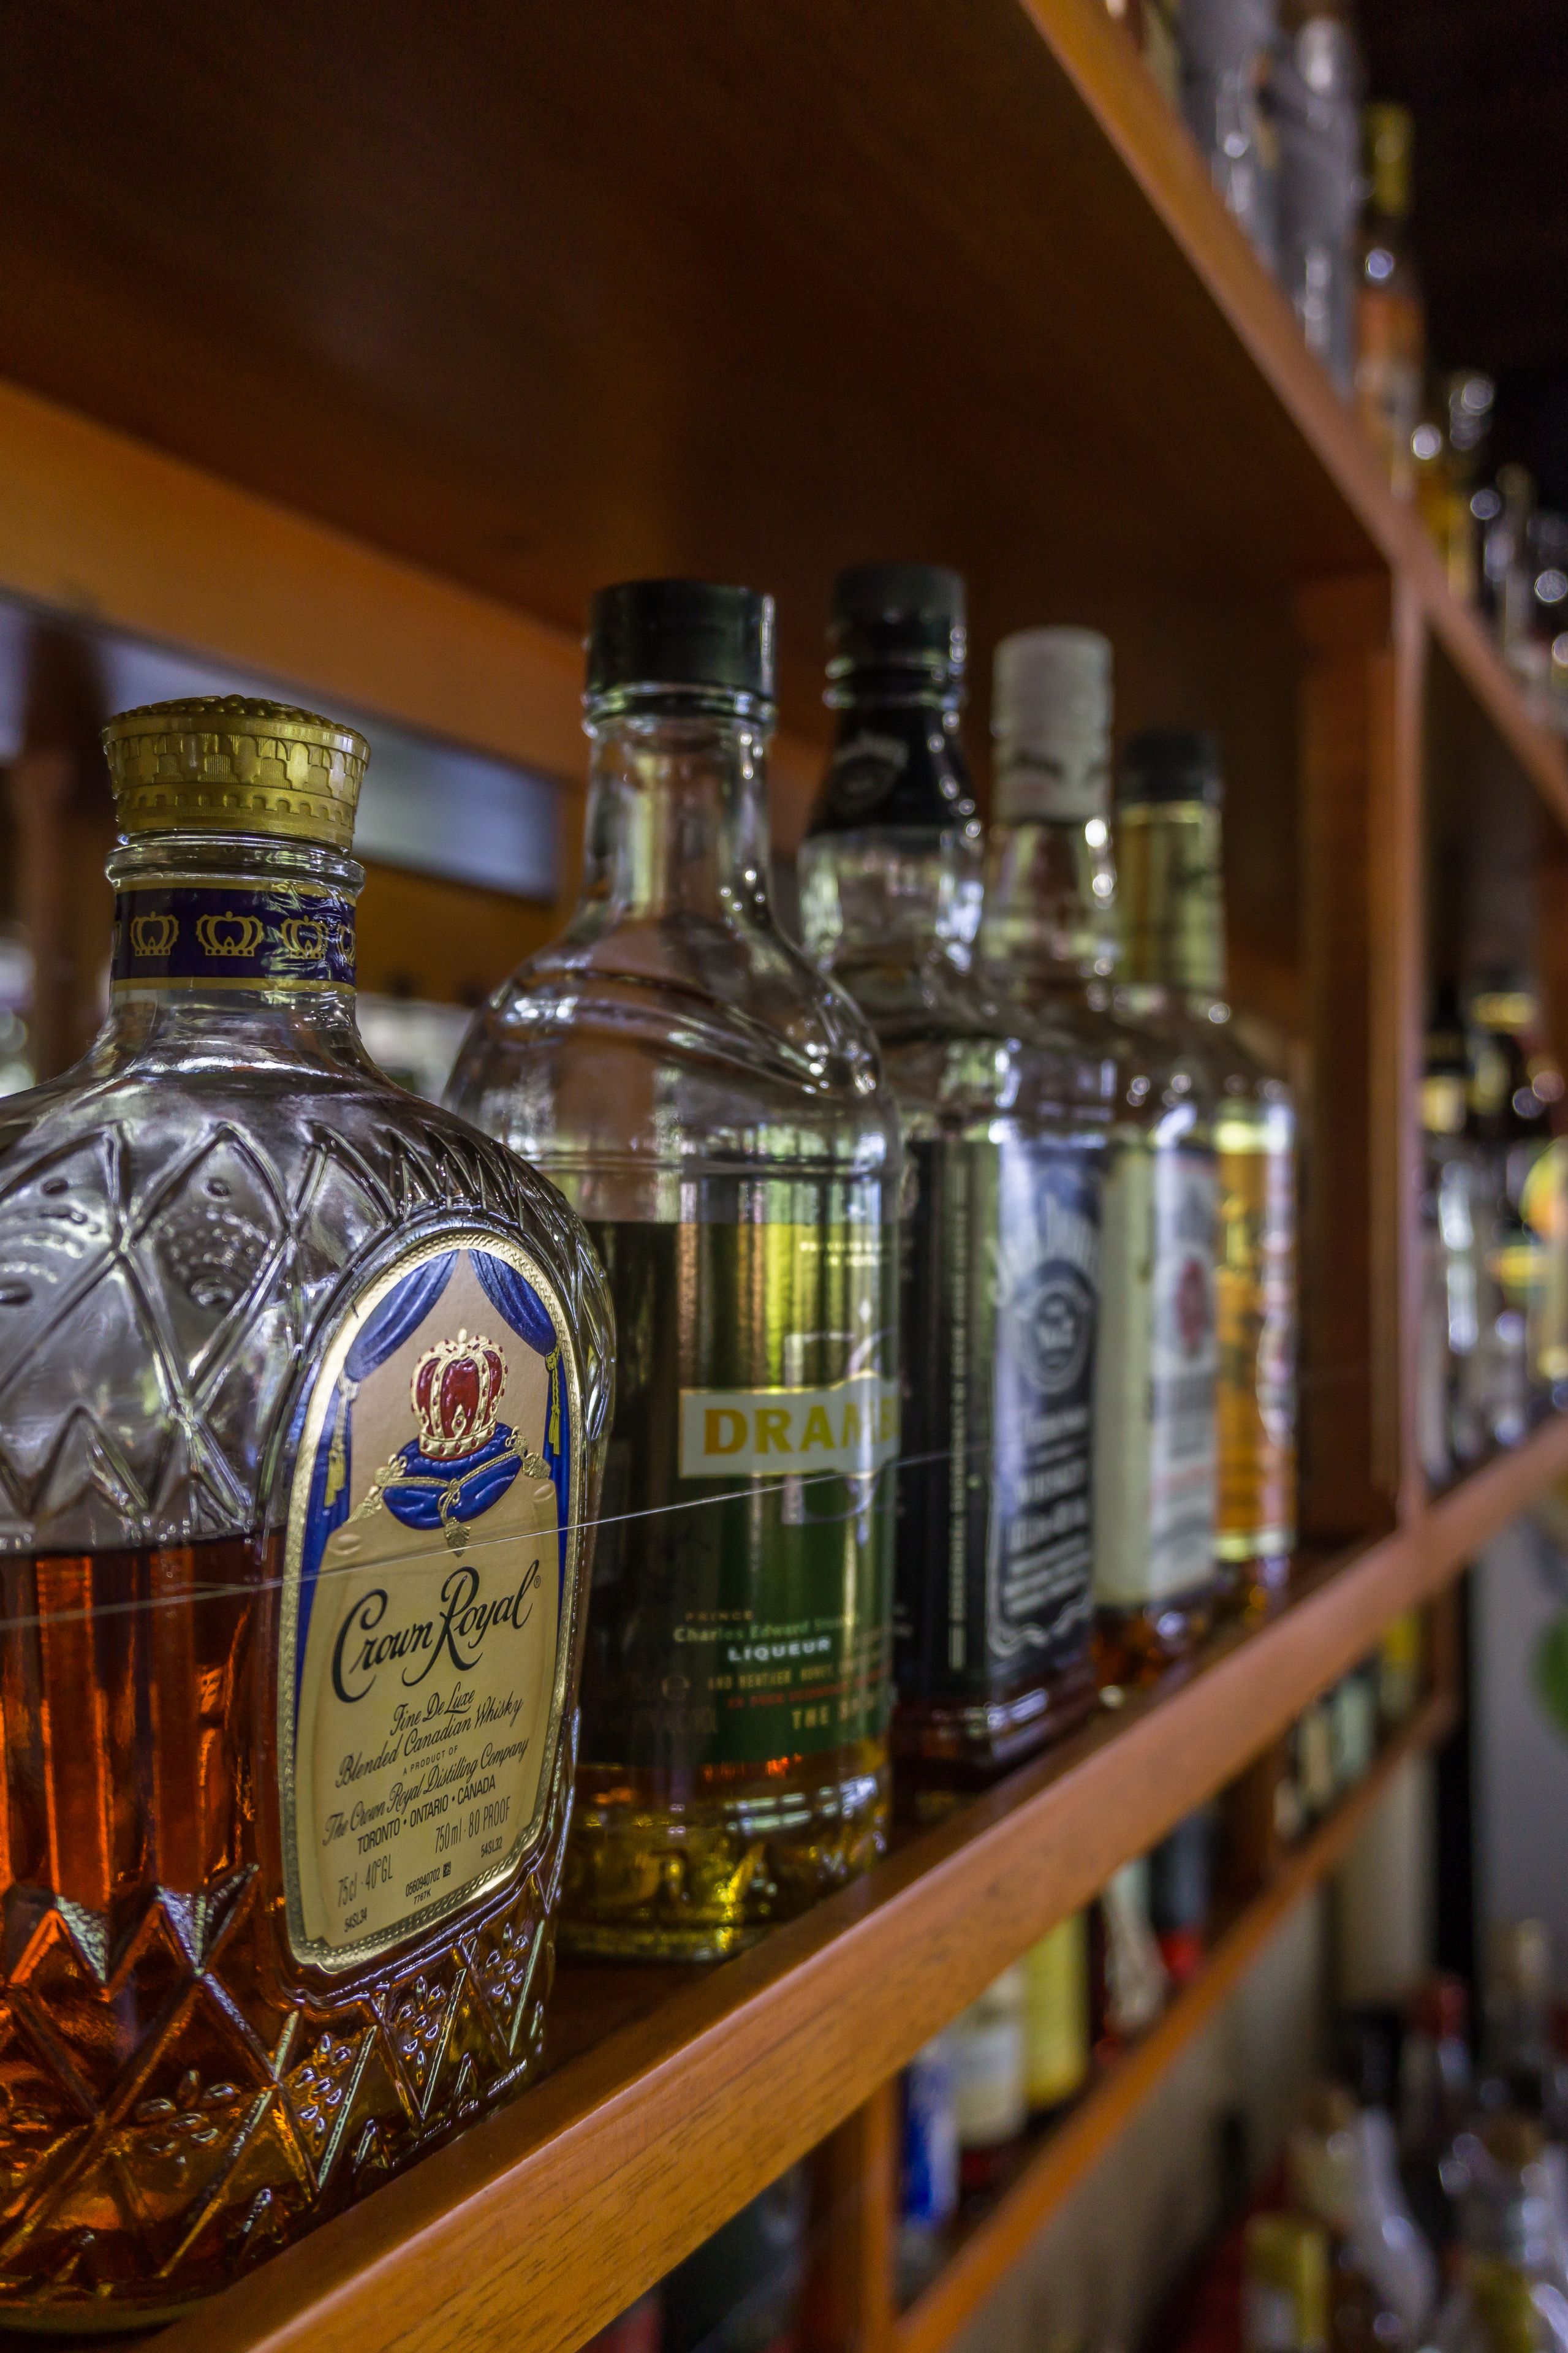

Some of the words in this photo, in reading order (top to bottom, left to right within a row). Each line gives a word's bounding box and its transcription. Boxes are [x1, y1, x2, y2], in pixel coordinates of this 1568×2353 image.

[331, 1588, 433, 1703] Crown
[727, 1635, 833, 1663] LIQUEUR
[390, 1703, 422, 1736] Fine
[423, 1692, 444, 1721] De
[444, 1681, 475, 1714] Luxe
[336, 1734, 403, 1787] Blended
[404, 1715, 471, 1756] Canadian
[474, 1691, 523, 1729] Whisky
[403, 1767, 407, 1775] A
[410, 1750, 445, 1771] PRODUCT
[449, 1745, 458, 1756] OF
[322, 1812, 350, 1846] The
[350, 1800, 385, 1831] Crown
[386, 1782, 422, 1815] Royal
[423, 1757, 478, 1794] Distilling
[480, 1738, 530, 1770] Company
[357, 1821, 400, 1855] TORONTO
[410, 1795, 449, 1828] ONTARIO
[458, 1775, 495, 1805] CANADA
[468, 1809, 481, 1839] 80
[483, 1795, 511, 1832] PROOF
[481, 1836, 503, 1858] 54SL32
[414, 1888, 431, 1905] 7767K
